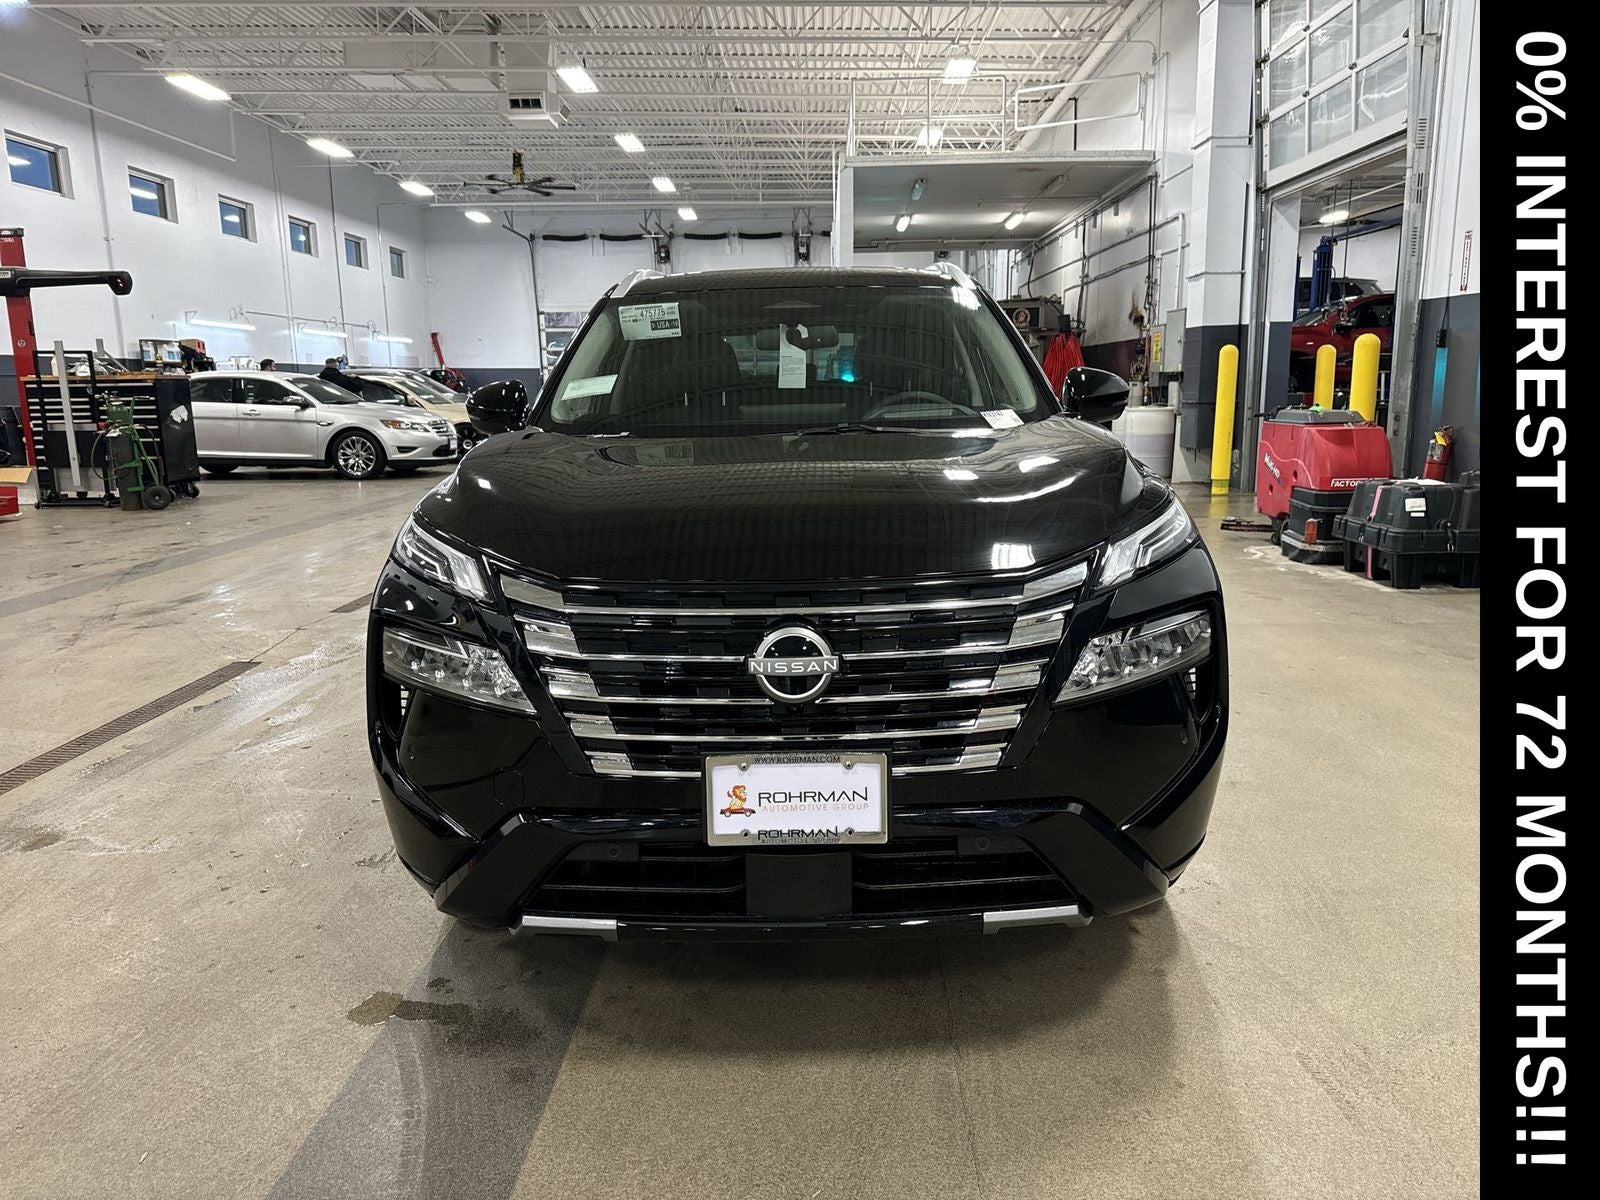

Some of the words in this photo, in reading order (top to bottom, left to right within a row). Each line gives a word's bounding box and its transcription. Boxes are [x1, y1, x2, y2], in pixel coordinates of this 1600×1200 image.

[639, 308, 666, 318] 475775
[750, 659, 837, 673] NISSAN
[753, 756, 840, 764] WWW.ROHRMAN.COM
[758, 786, 868, 807] ROHRMAN
[762, 803, 828, 813] AUTOMOTIVE
[832, 803, 869, 811] GROUP
[758, 825, 838, 840] ROHRMAN
